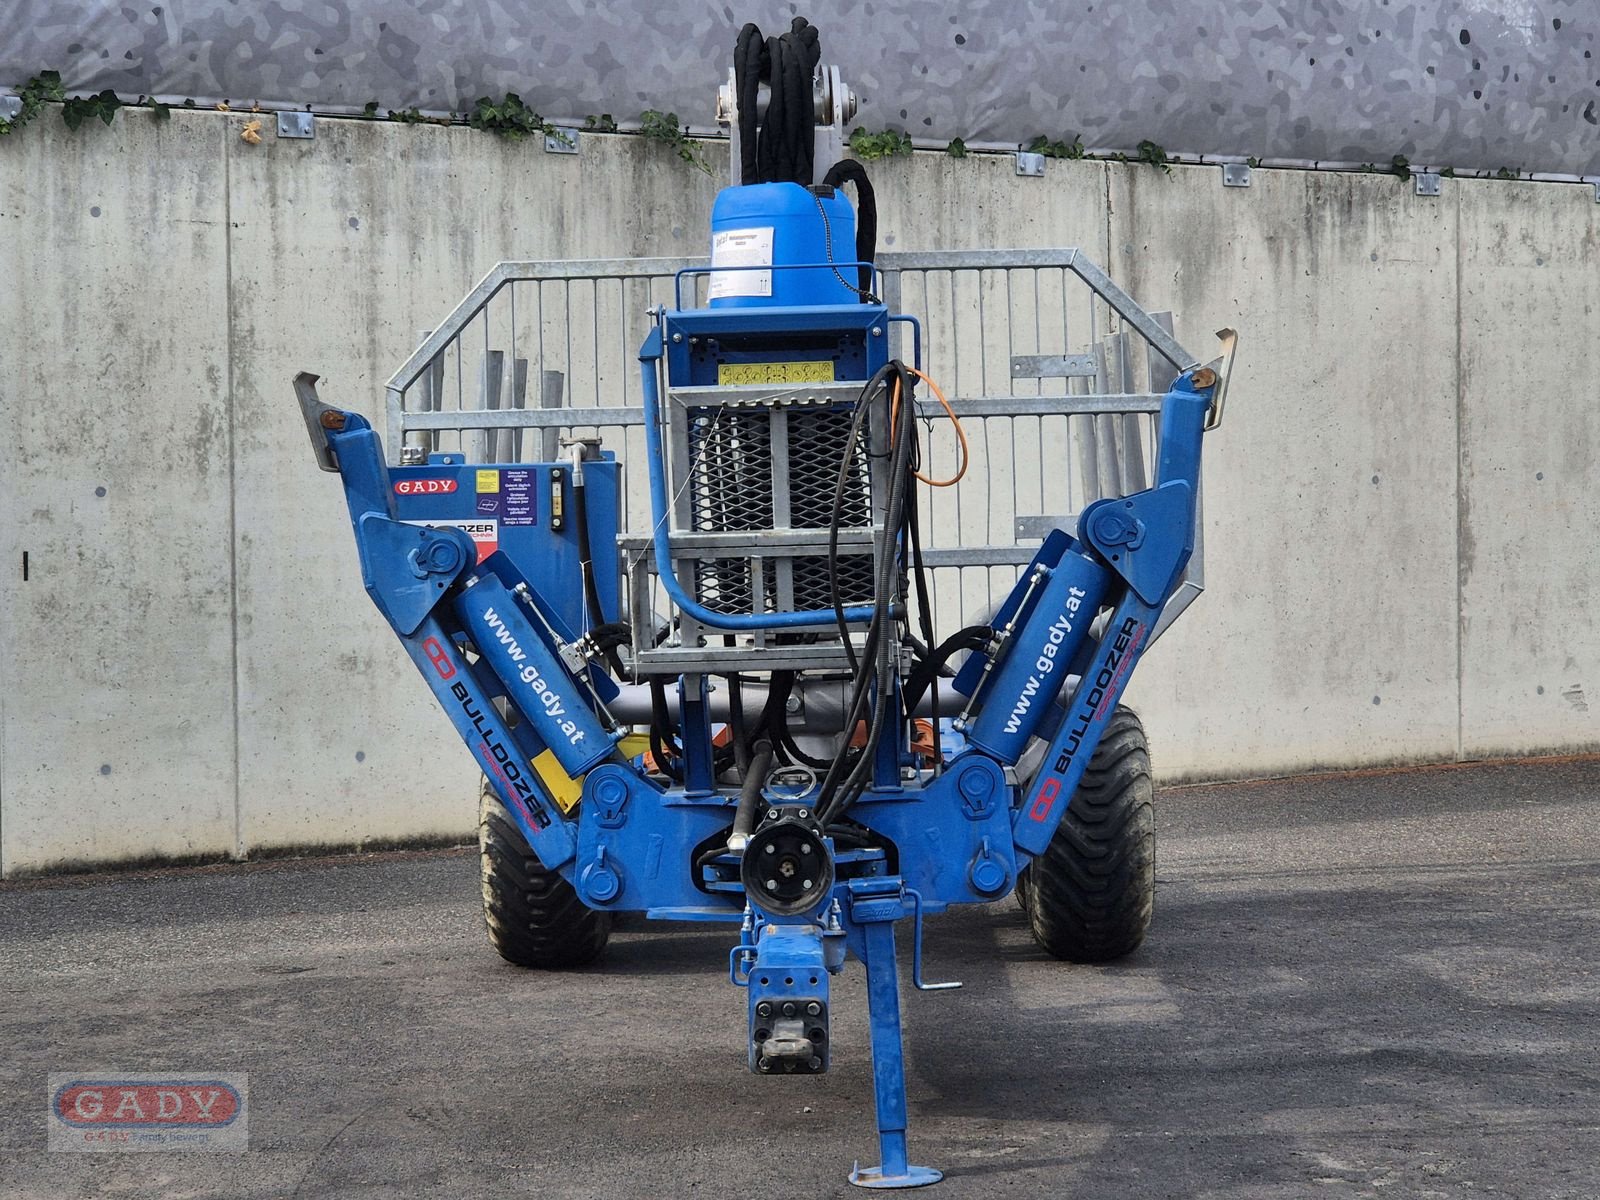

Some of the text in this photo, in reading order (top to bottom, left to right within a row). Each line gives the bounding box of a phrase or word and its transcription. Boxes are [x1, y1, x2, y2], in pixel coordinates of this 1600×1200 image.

[399, 480, 452, 493] GADY
[483, 607, 585, 745] www.gady.at
[1003, 586, 1086, 734] www.gady.at
[1054, 616, 1139, 776] BULLDOZER
[451, 681, 552, 830] BULLDOZER
